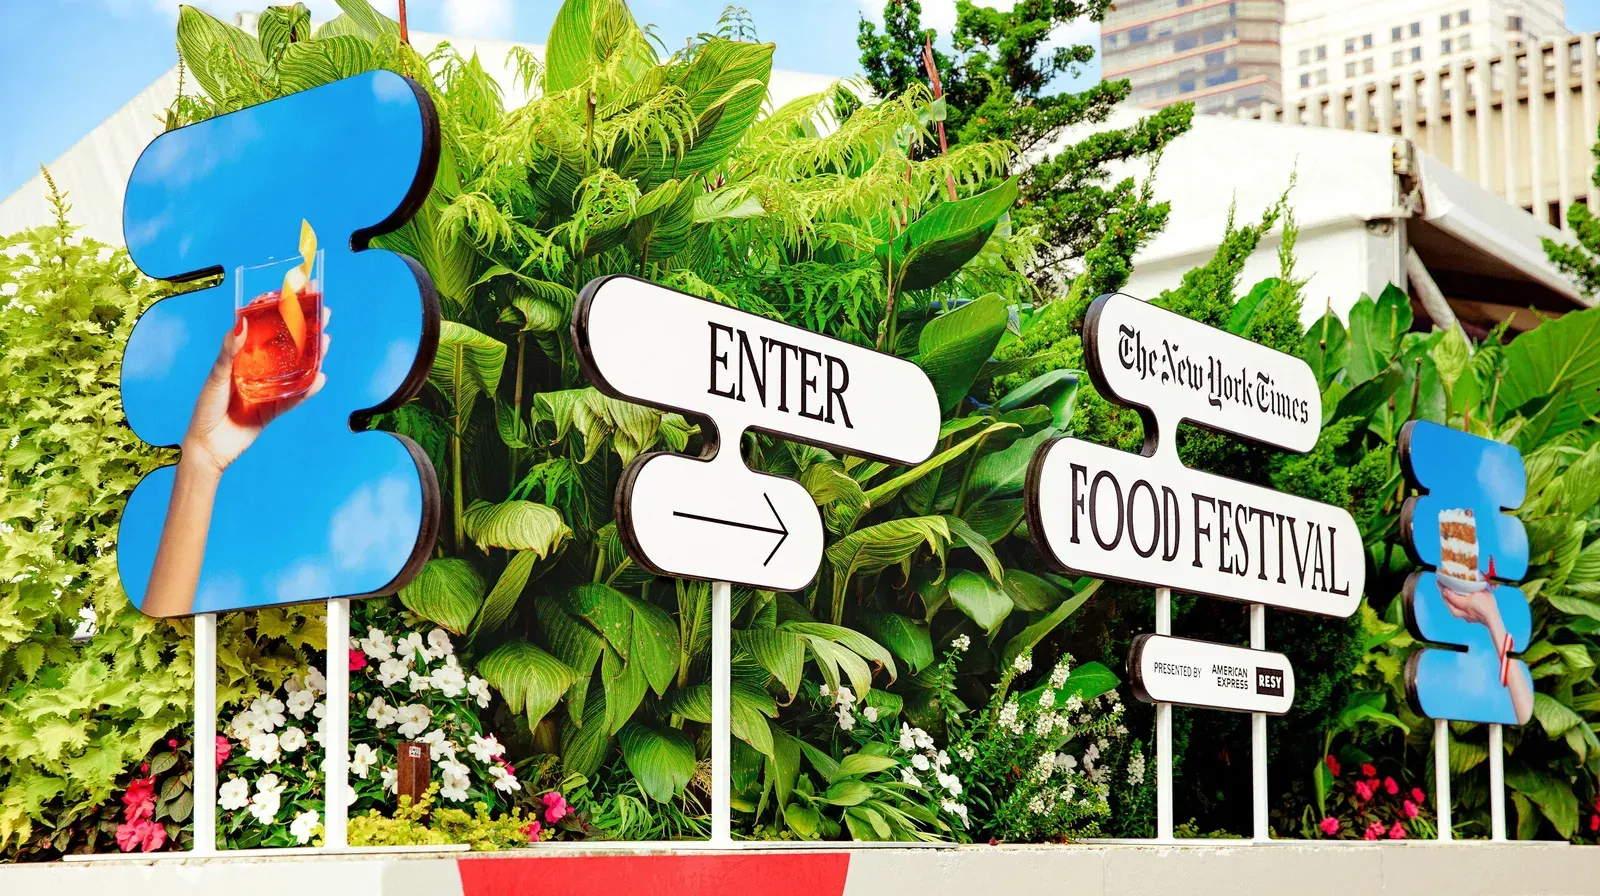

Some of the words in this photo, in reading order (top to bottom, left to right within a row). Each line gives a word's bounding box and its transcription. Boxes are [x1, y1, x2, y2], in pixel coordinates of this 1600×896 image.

[707, 320, 854, 429] ENTER
[1118, 323, 1159, 381] The
[1161, 339, 1204, 391] New
[1207, 355, 1253, 411] York
[1256, 371, 1309, 424] Times
[1069, 462, 1181, 562] FOOD
[1191, 492, 1350, 597] FESTIVAL
[1154, 661, 1192, 677] PRESENTED
[1193, 667, 1202, 678] BY
[1211, 664, 1248, 678] AMERICAN
[1217, 677, 1248, 689] EXPRESS
[1258, 674, 1282, 689] RESY
